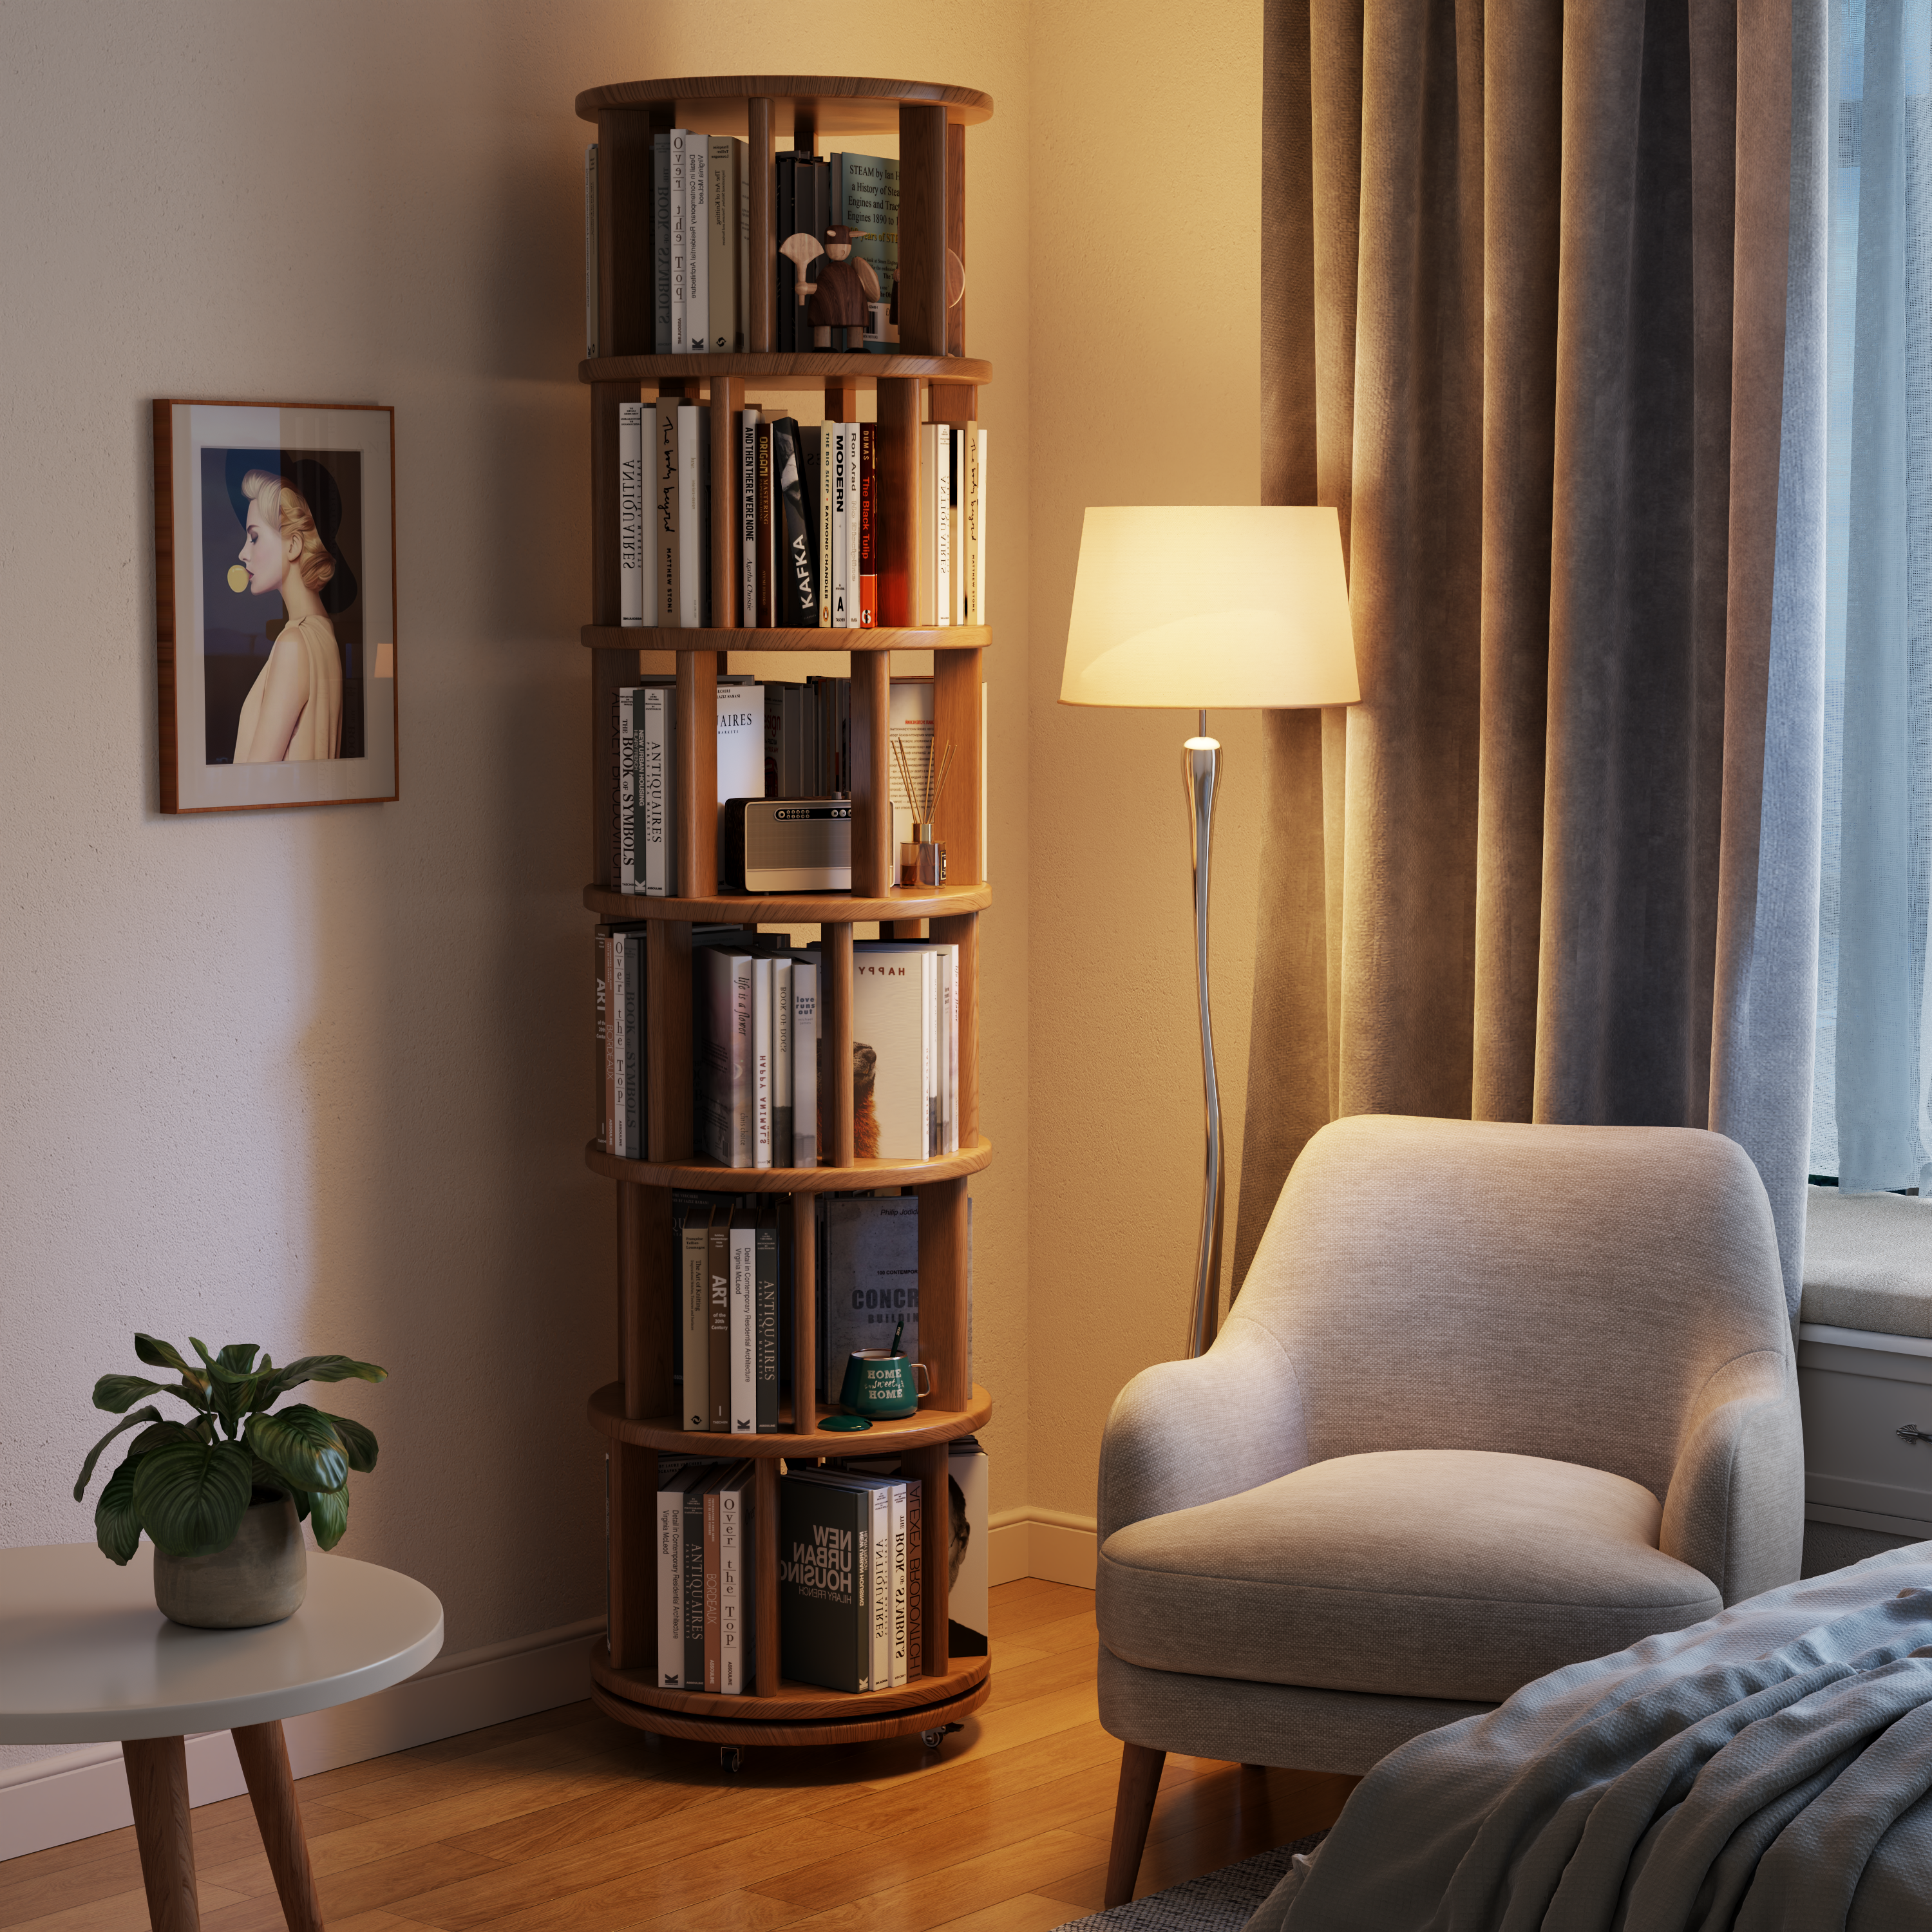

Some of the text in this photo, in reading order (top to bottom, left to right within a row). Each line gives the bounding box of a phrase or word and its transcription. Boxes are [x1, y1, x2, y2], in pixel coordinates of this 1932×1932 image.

[849, 164, 874, 178] STEAM
[875, 167, 884, 181] by
[885, 169, 894, 180] Ian
[848, 196, 871, 209] Engines
[873, 200, 884, 210] and
[857, 182, 879, 196] History
[880, 185, 887, 195] of
[888, 186, 900, 198] Stea
[848, 211, 895, 226] Engines 1890 to
[658, 416, 677, 533] The body beyond
[745, 427, 753, 542] AND THEN THERE WERE NONE
[851, 501, 857, 518] No
[861, 533, 870, 560] Tulip
[792, 534, 814, 610] KAFKA
[837, 596, 844, 612] A
[623, 737, 634, 778] BOOK
[623, 781, 628, 791] OF
[650, 741, 661, 842] ANTIQUAIRES
[623, 793, 634, 866] SYMBOLS
[734, 976, 750, 990] life
[738, 992, 748, 1001] is
[626, 991, 635, 1035] BOOK
[734, 1009, 750, 1036] flower
[626, 1038, 630, 1048] OF
[626, 1051, 636, 1128] SYMBOLS
[880, 1209, 898, 1217] Philip
[712, 1275, 727, 1307] ART
[743, 1272, 752, 1314] Contemporary
[851, 1288, 919, 1310] CONCR
[762, 1280, 775, 1381] ANTIQUAIRES
[867, 1313, 919, 1324] BUILDIN
[867, 1369, 902, 1379] HOME
[868, 1388, 903, 1399] HOME
[661, 1510, 669, 1531] Virginia
[671, 1533, 679, 1573] Contemporary
[724, 1499, 735, 1645] Over the Top
[690, 1544, 703, 1640] ANTIQUAIRES
[706, 1573, 717, 1624] BORDEAUX
